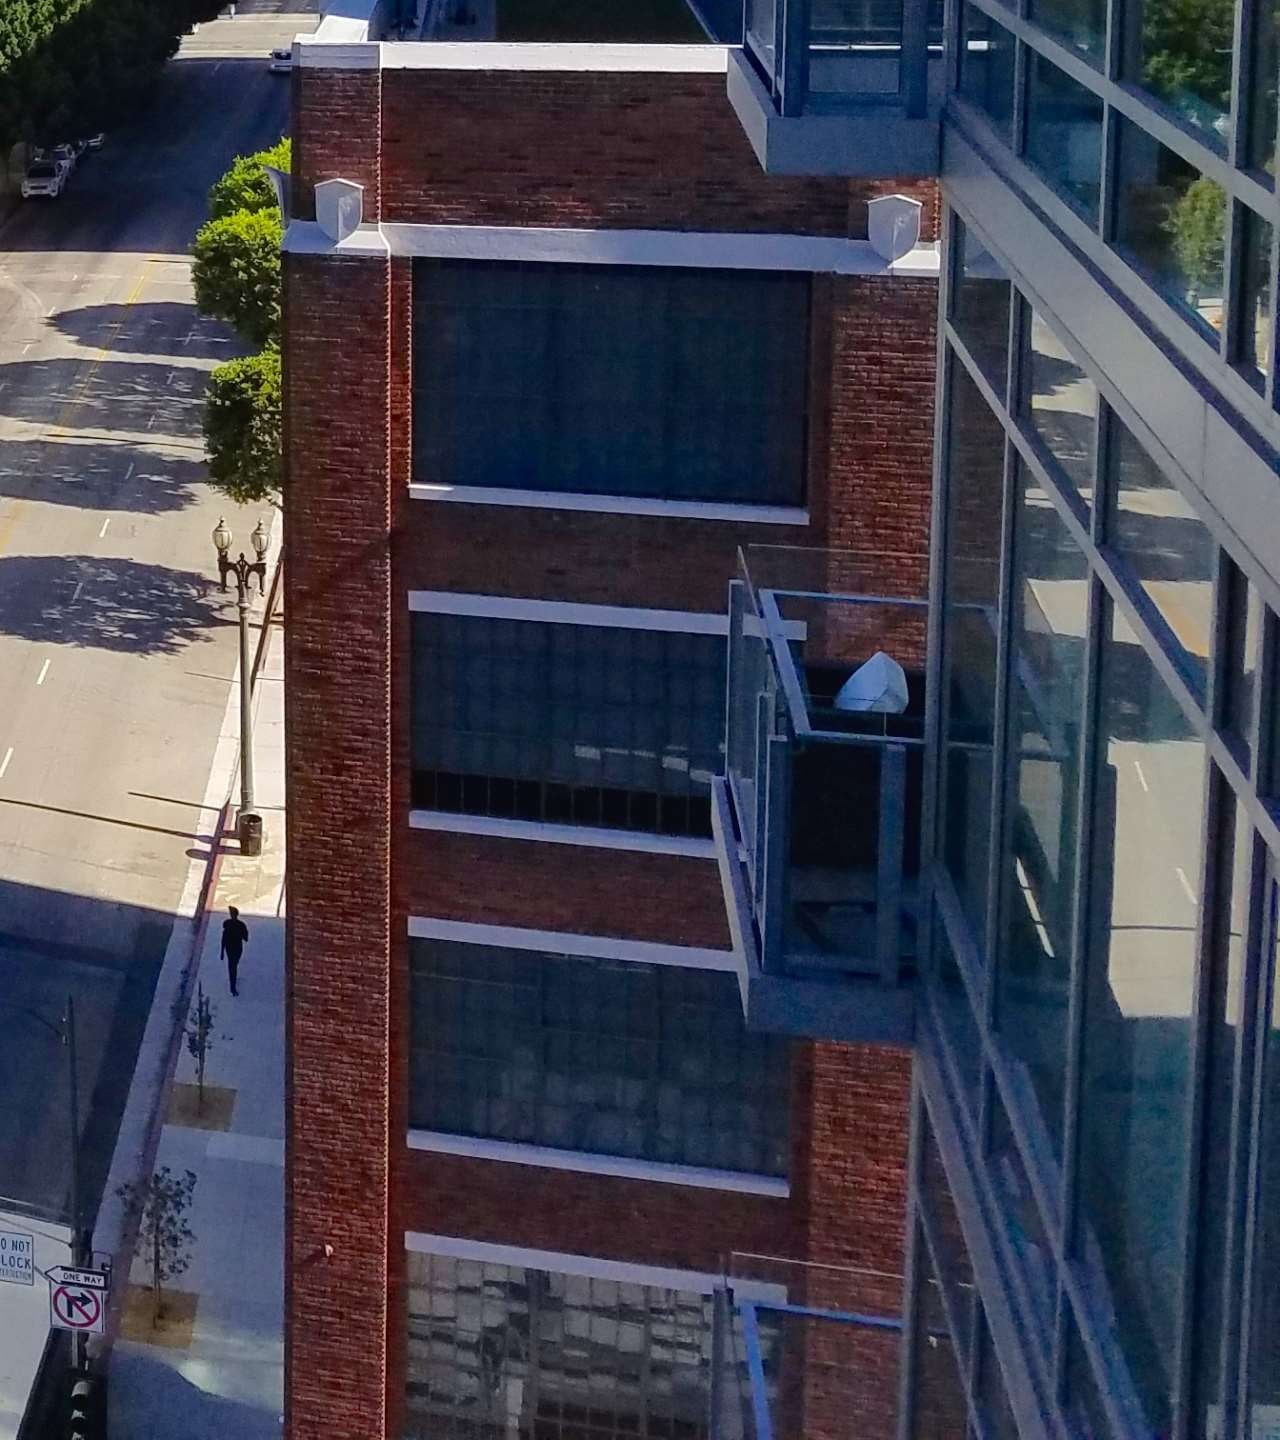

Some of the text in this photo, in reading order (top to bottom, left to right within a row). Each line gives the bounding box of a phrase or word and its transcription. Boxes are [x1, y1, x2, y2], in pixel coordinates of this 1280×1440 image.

[11, 1240, 30, 1252] NOT
[63, 1272, 102, 1285] ONE WAY
